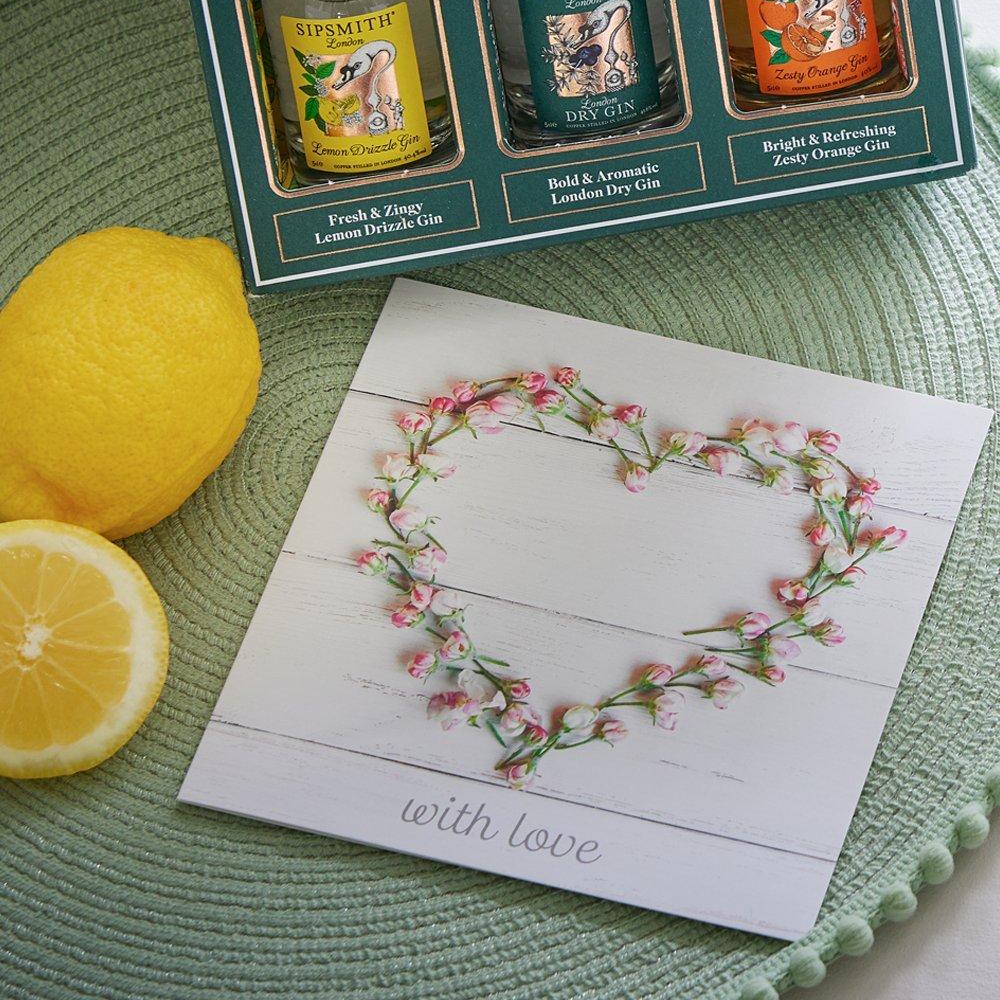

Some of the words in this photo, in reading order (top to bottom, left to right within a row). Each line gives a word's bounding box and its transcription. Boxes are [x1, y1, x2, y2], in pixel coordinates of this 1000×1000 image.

[296, 13, 393, 37] SIPSMITH
[326, 37, 365, 50] London
[774, 69, 806, 83] Zesty
[807, 63, 848, 78] Orange
[848, 53, 869, 72] Gin
[565, 108, 600, 122] DRY
[604, 99, 635, 118] GIN
[581, 96, 619, 110] London
[311, 141, 349, 157] Lemon
[349, 138, 398, 157] Drizzle
[397, 133, 421, 151] Gin
[762, 136, 806, 153] Bright
[809, 133, 821, 145] &
[822, 123, 897, 144] Refreshing
[772, 152, 810, 167] Zesty
[811, 144, 863, 160] Orange
[864, 139, 891, 152] Gin
[547, 174, 580, 190] Bold
[582, 172, 594, 185] &
[596, 162, 660, 183] Aromatic
[551, 187, 604, 205] London
[606, 183, 632, 196] Dry
[635, 177, 661, 191] Gin
[328, 209, 368, 227] Fresh
[370, 207, 382, 219] &
[384, 202, 424, 217] Zingy
[315, 229, 362, 245] Lemon
[364, 217, 415, 236] Drizzle
[416, 213, 443, 227] Gin
[400, 796, 500, 841] with
[508, 812, 603, 864] love
